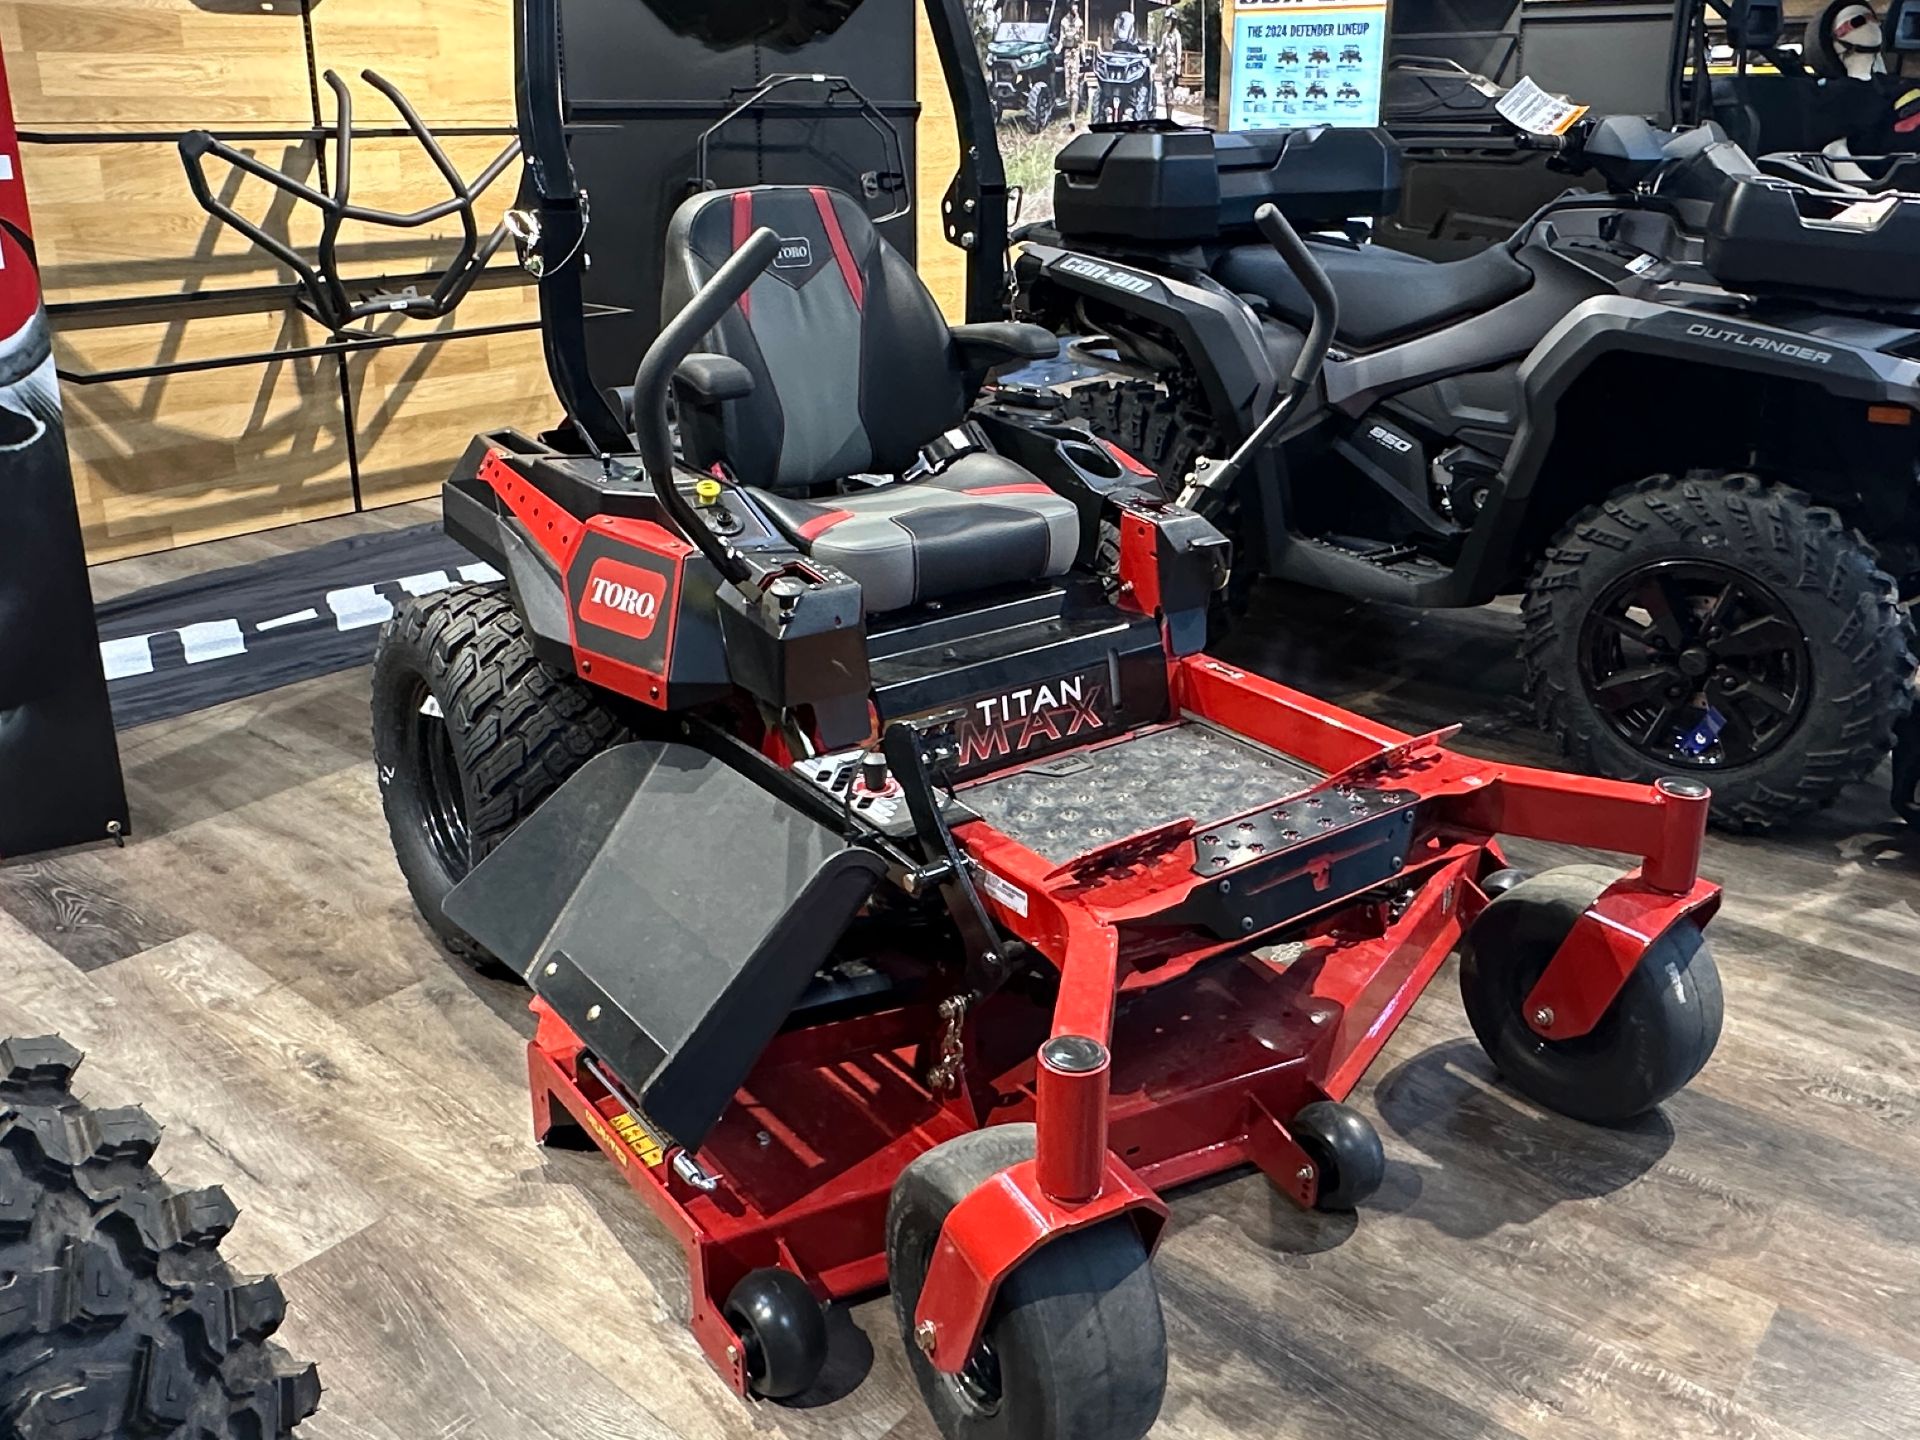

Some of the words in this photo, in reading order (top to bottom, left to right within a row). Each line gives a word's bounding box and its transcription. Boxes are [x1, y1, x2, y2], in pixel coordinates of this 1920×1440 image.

[1247, 25, 1263, 38] THE
[1265, 24, 1287, 38] 2024
[1290, 23, 1334, 37] DEFENDER
[1337, 22, 1370, 36] LINEUP
[1060, 257, 1153, 294] can-am
[1686, 323, 1833, 364] OUTLANDER
[591, 577, 655, 619] TORO
[976, 675, 1084, 726] TITAN
[959, 685, 1104, 767] MAX
